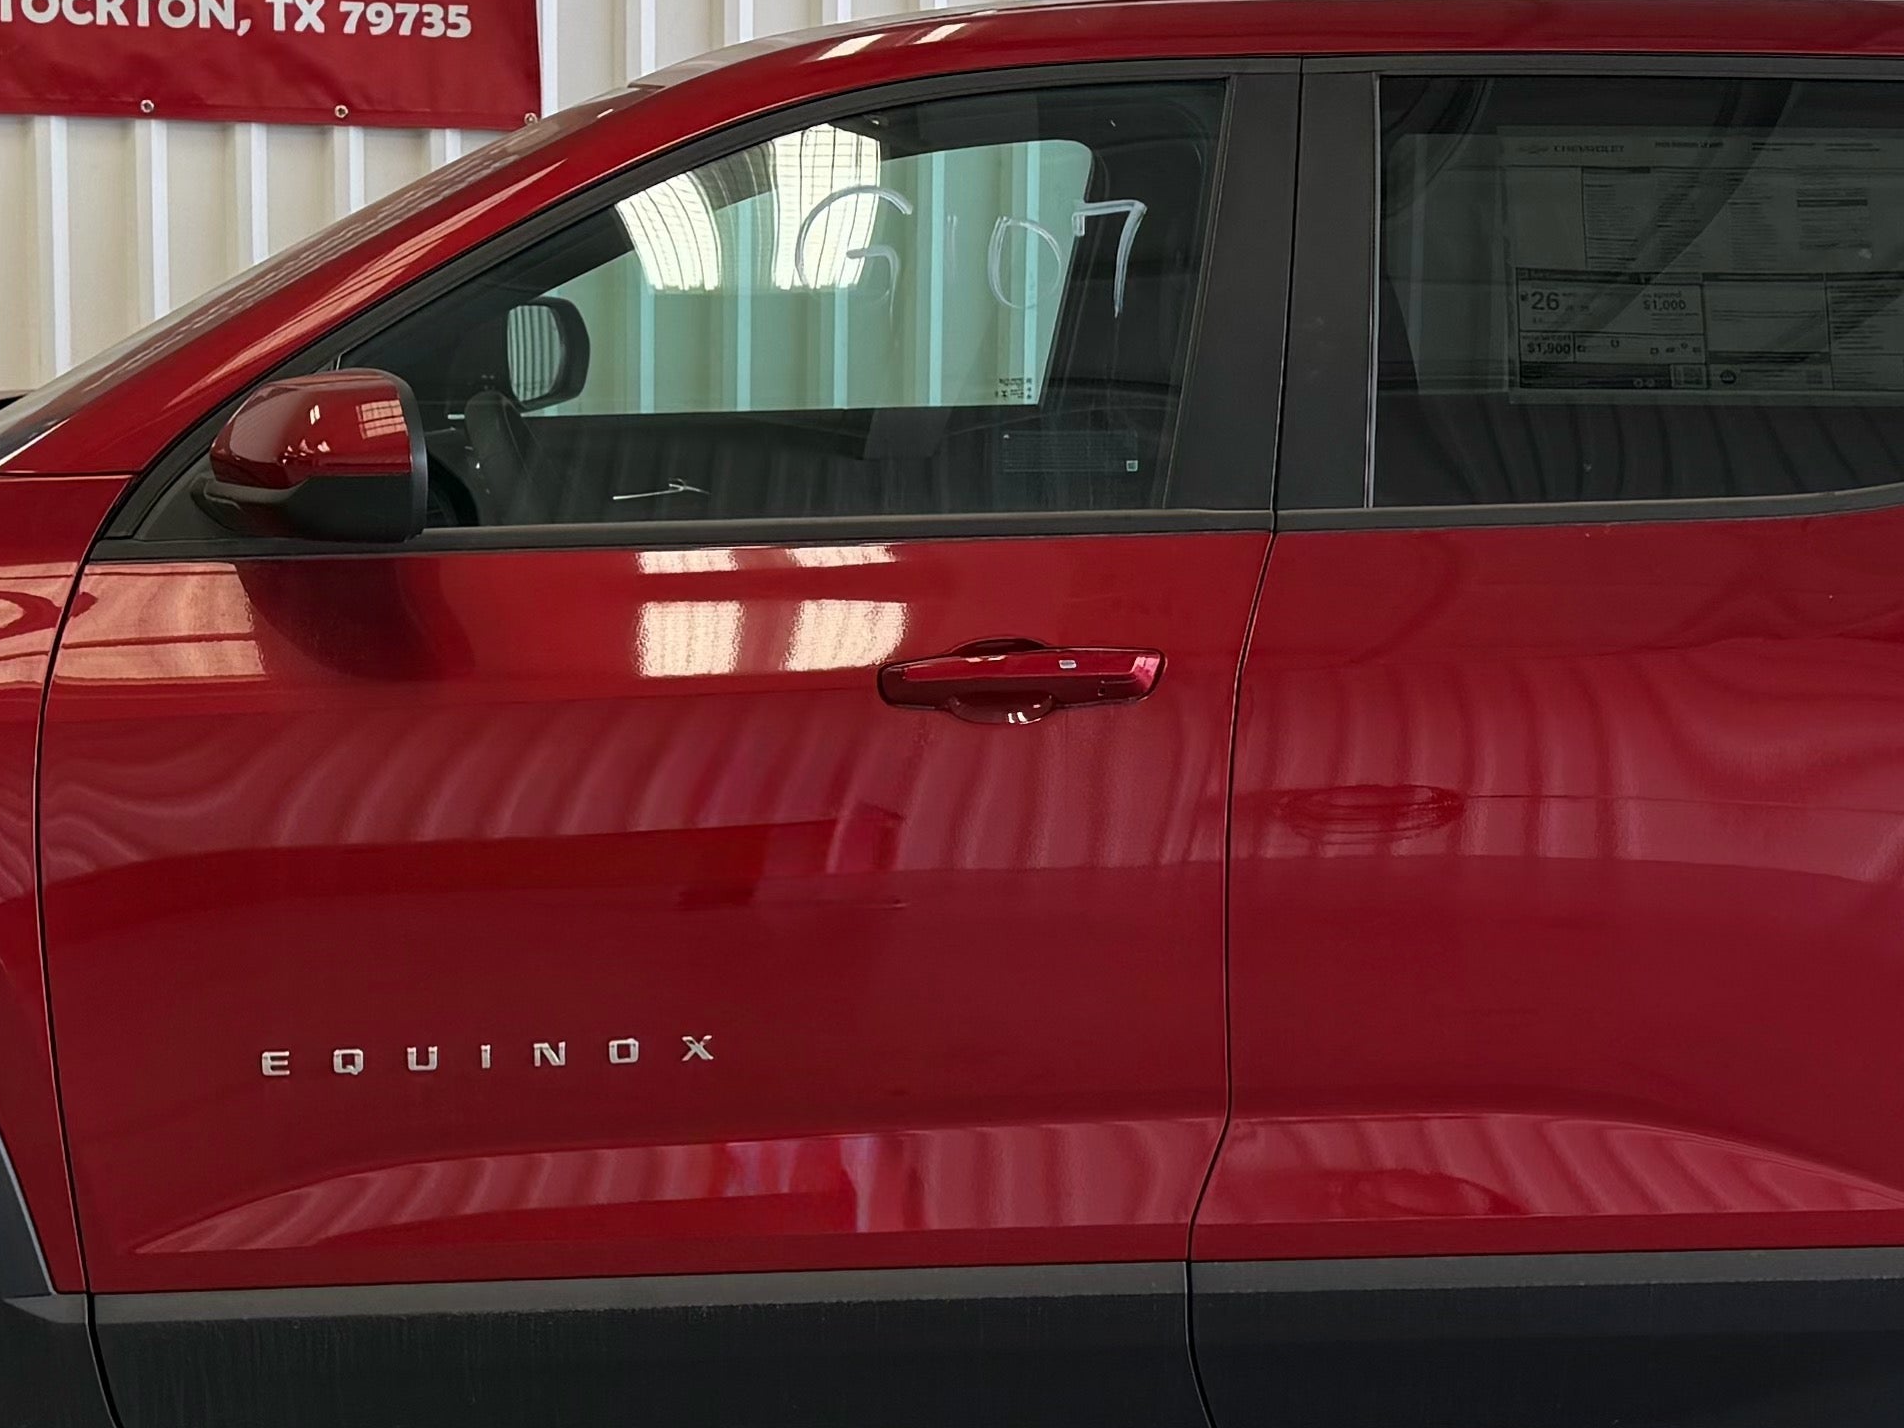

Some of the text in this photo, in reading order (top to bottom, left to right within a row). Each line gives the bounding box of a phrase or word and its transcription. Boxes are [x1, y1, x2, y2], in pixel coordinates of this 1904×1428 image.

[339, 0, 472, 38] 79735
[1530, 290, 1560, 311] 26
[261, 1034, 714, 1076] EQUINOX
